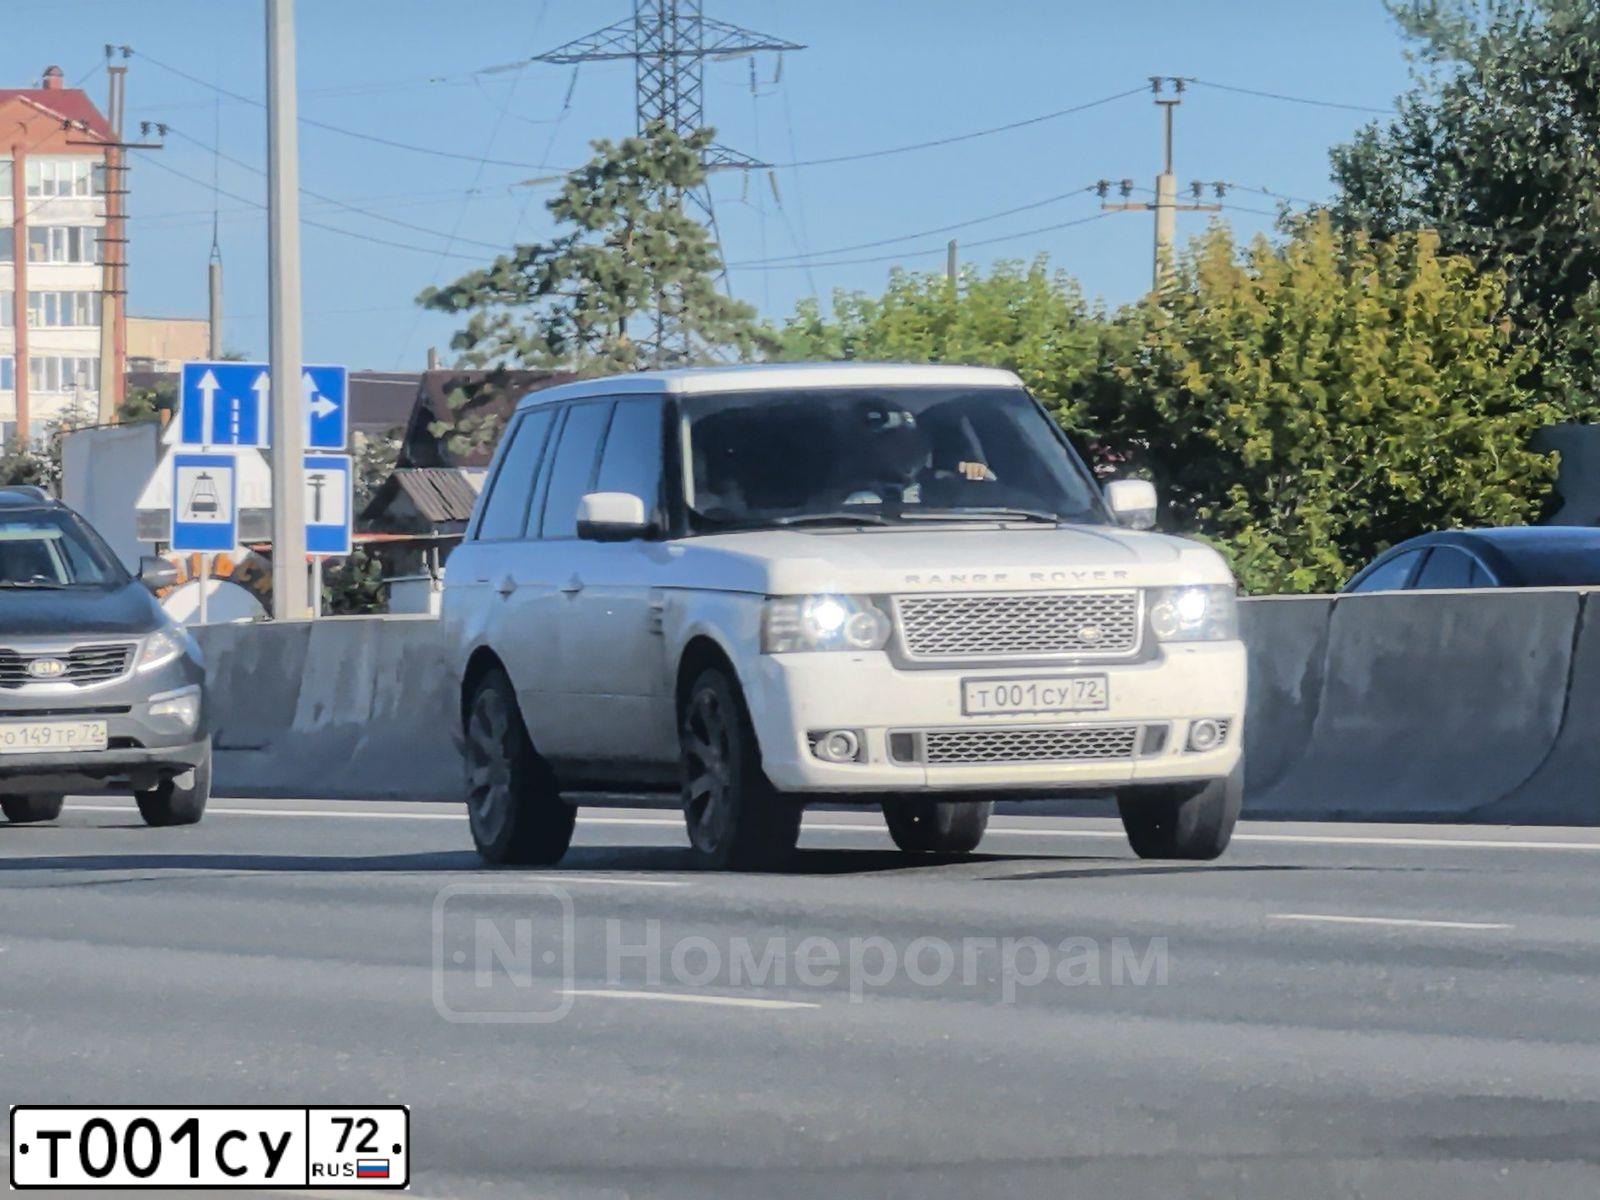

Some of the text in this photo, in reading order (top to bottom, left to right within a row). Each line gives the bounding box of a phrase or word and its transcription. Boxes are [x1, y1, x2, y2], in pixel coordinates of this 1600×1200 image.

[904, 570, 1128, 585] RANGE ROVER
[1076, 681, 1098, 699] 72
[82, 724, 100, 738] 72
